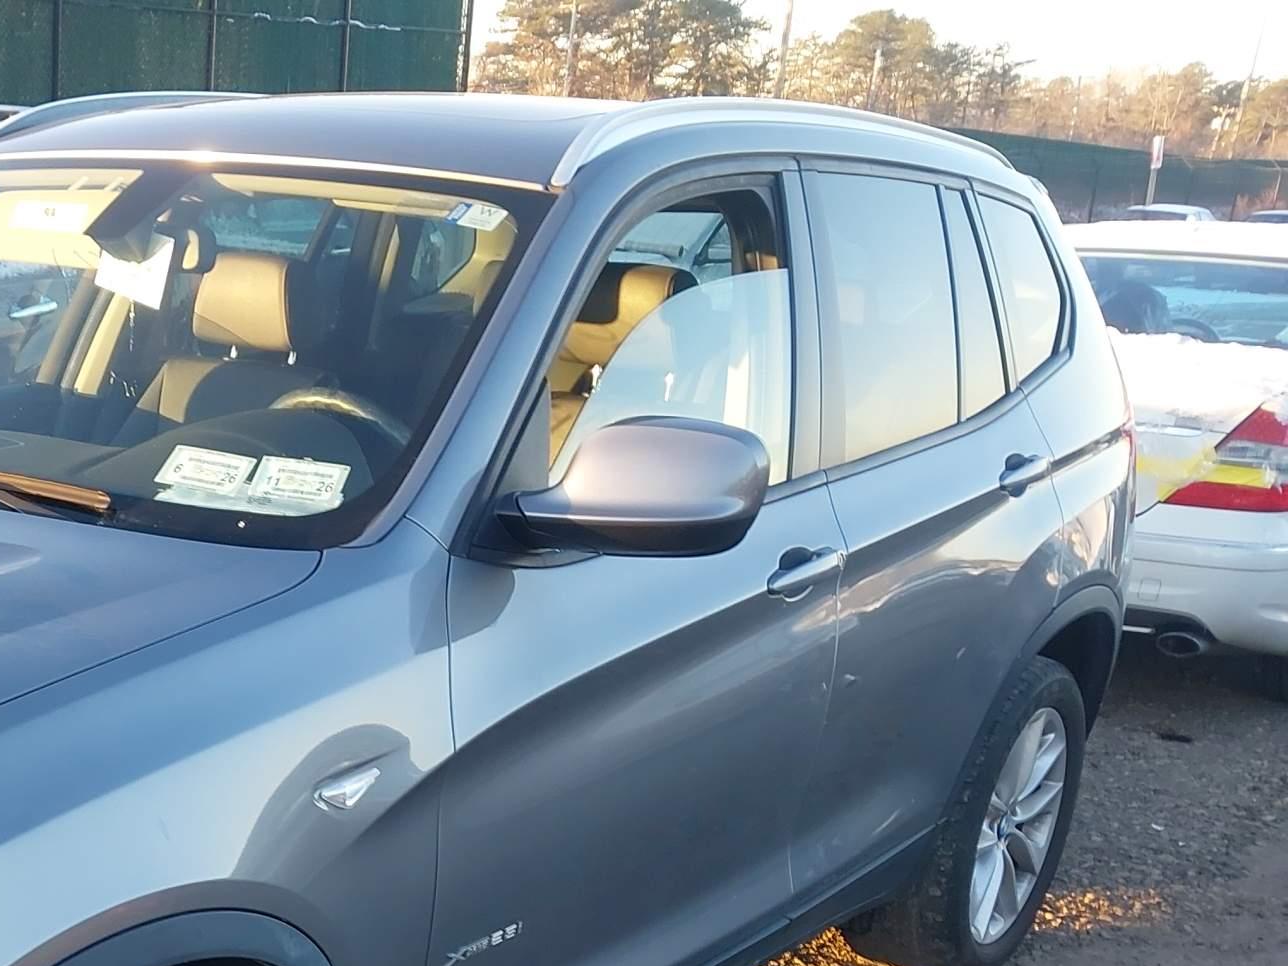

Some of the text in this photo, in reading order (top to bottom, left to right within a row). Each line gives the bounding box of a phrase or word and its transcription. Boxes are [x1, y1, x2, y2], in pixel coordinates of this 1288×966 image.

[173, 463, 184, 474] 6
[220, 472, 237, 485] 26
[266, 475, 280, 487] 11
[315, 481, 333, 493] 26
